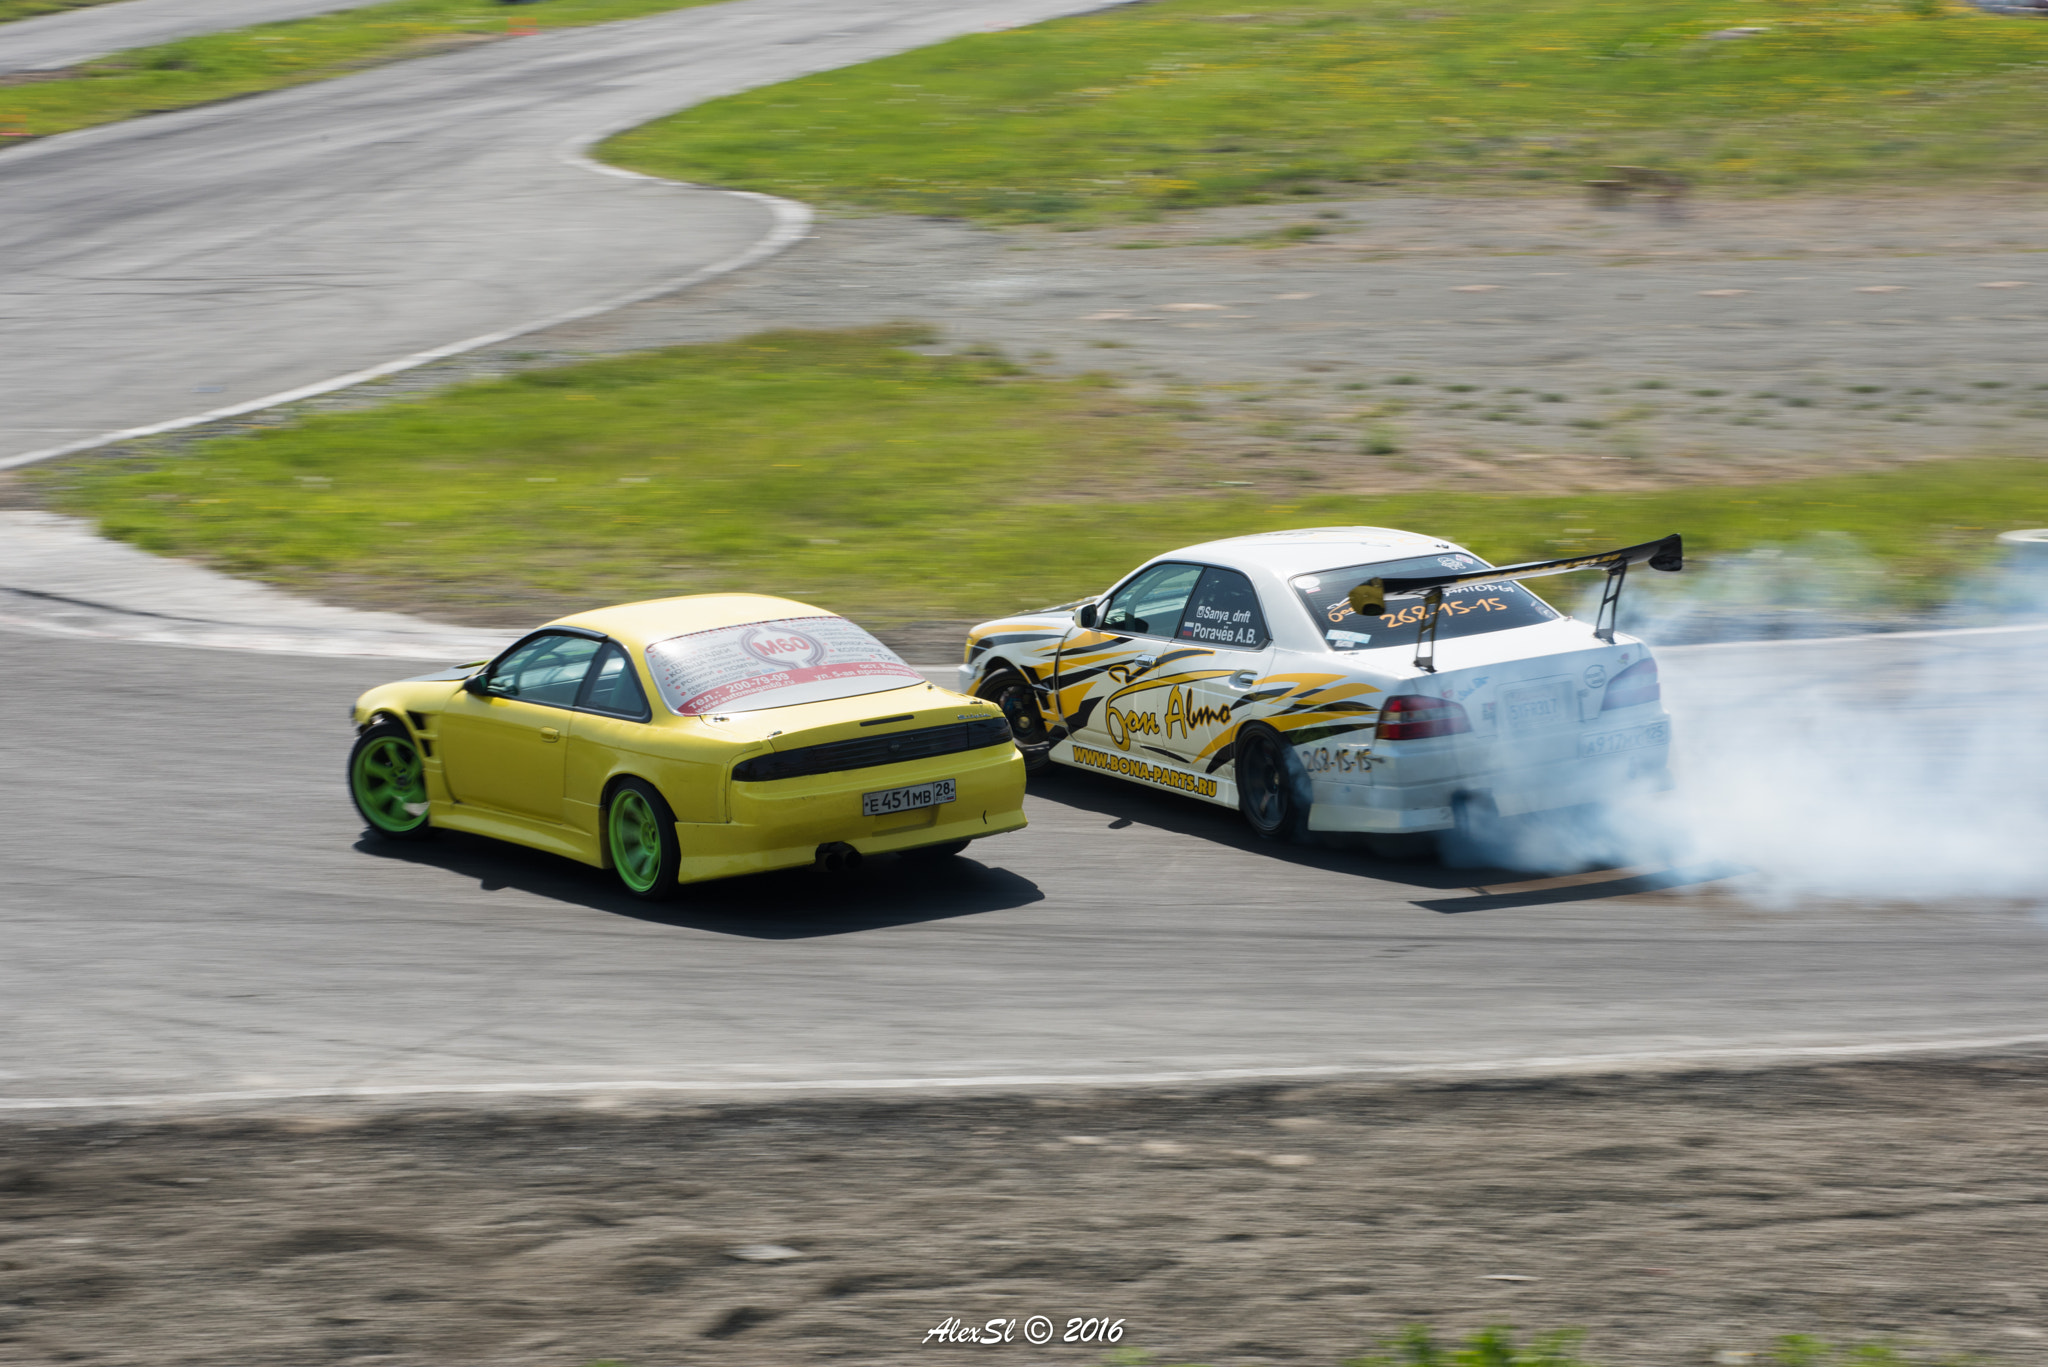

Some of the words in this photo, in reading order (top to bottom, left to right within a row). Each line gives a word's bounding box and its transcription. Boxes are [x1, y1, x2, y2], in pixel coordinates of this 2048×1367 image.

[1379, 597, 1508, 628] 268-15-15
[1192, 622, 1234, 642] Рогачёв
[1234, 627, 1257, 645] А.В.
[688, 690, 722, 709] тел.:
[725, 672, 790, 693] 200-79-09
[1072, 745, 1218, 798] WWW.BONA-PARTS.RU
[935, 782, 950, 797] 28
